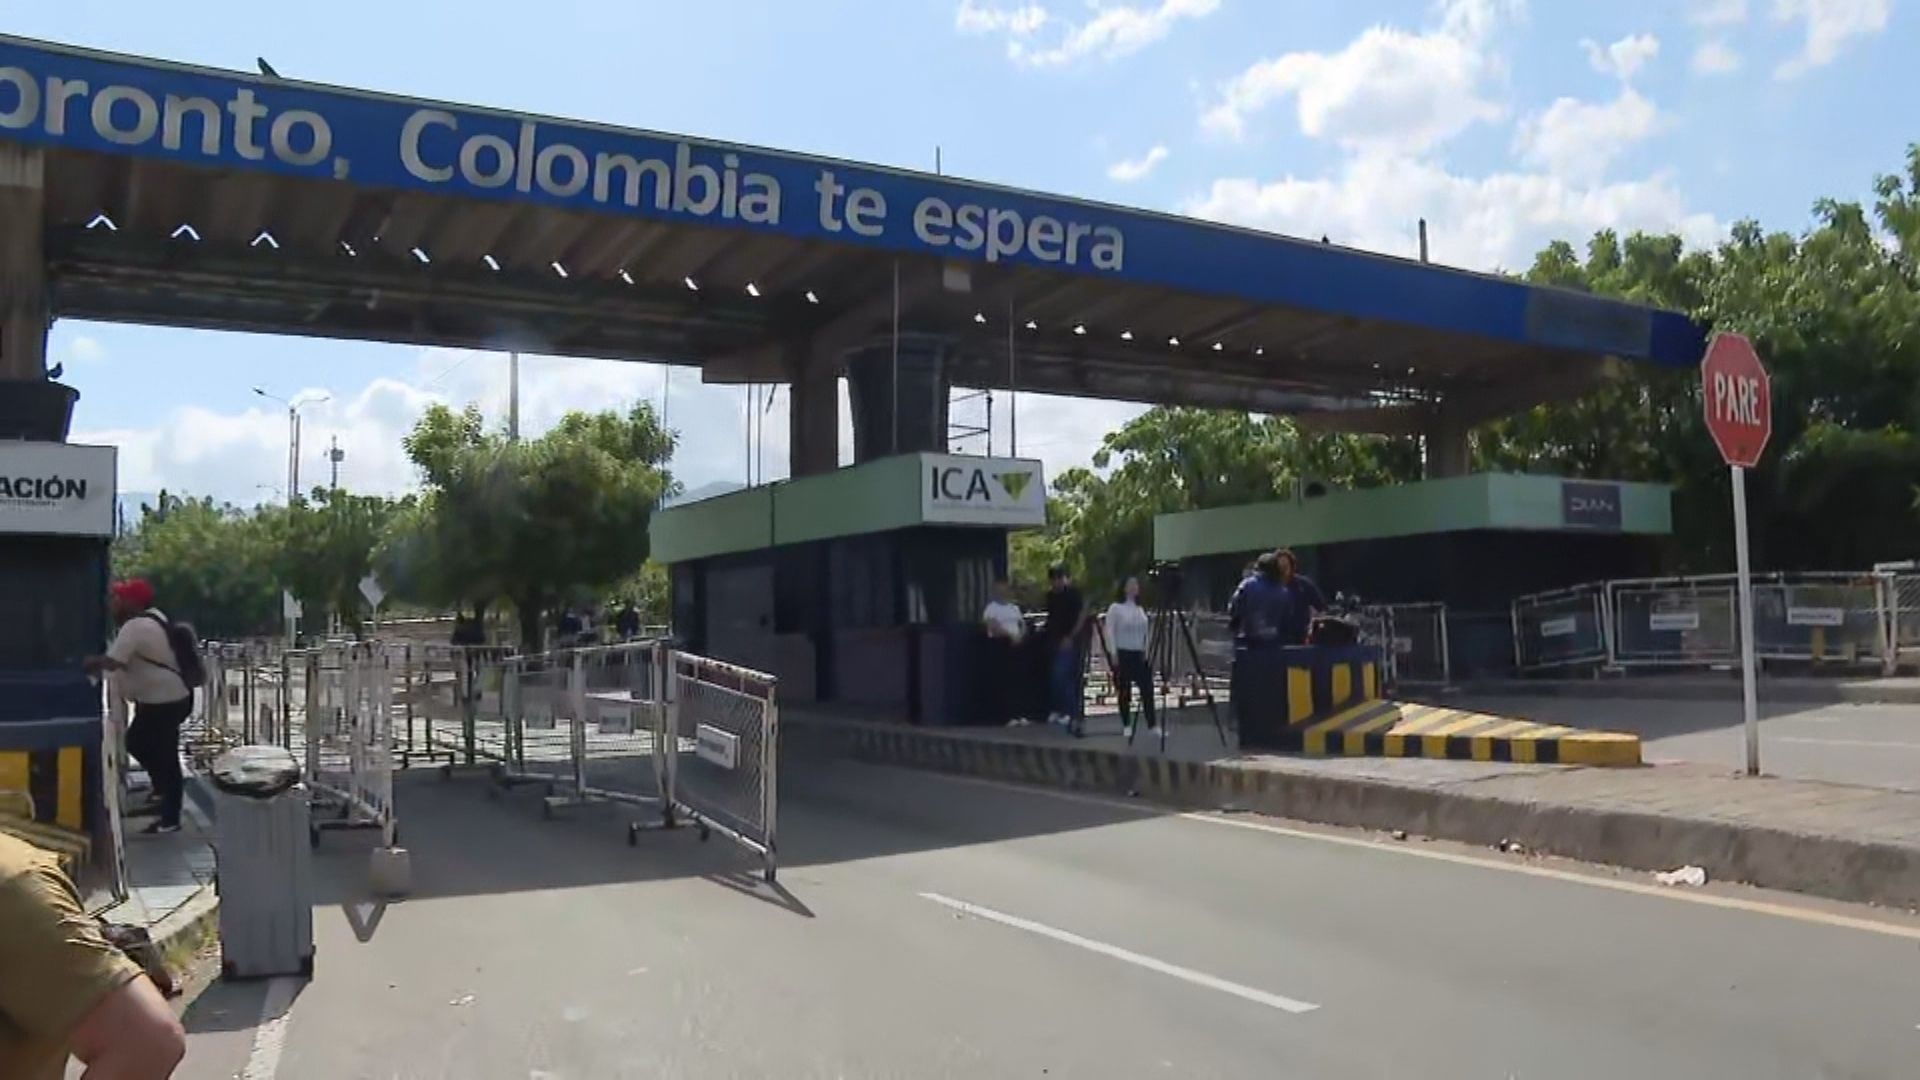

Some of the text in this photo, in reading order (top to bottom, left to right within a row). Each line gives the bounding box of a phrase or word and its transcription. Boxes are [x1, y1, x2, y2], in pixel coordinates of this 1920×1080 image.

[400, 109, 781, 226] Colombia
[815, 171, 887, 237] te
[913, 197, 1124, 272] espera
[1714, 371, 1761, 426] PARE
[932, 466, 991, 501] ICA
